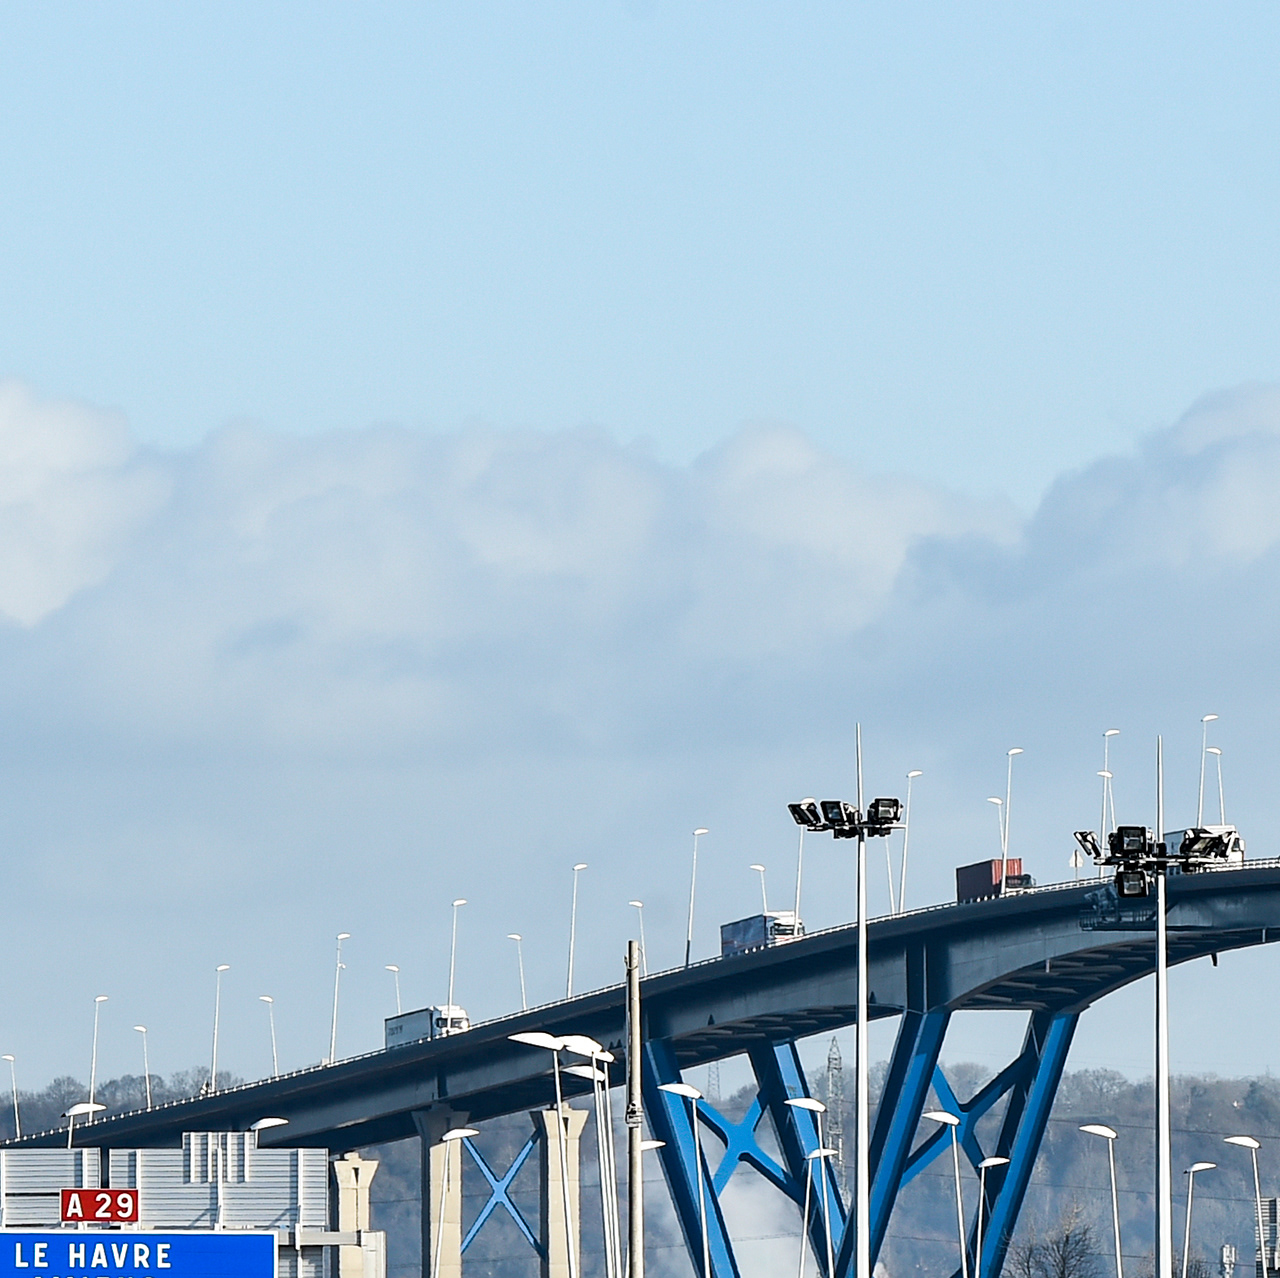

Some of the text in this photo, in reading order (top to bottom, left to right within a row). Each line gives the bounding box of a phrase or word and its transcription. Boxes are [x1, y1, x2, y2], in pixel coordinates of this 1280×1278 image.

[67, 1193, 133, 1217] A 29
[15, 1243, 171, 1268] LE HAVRE
